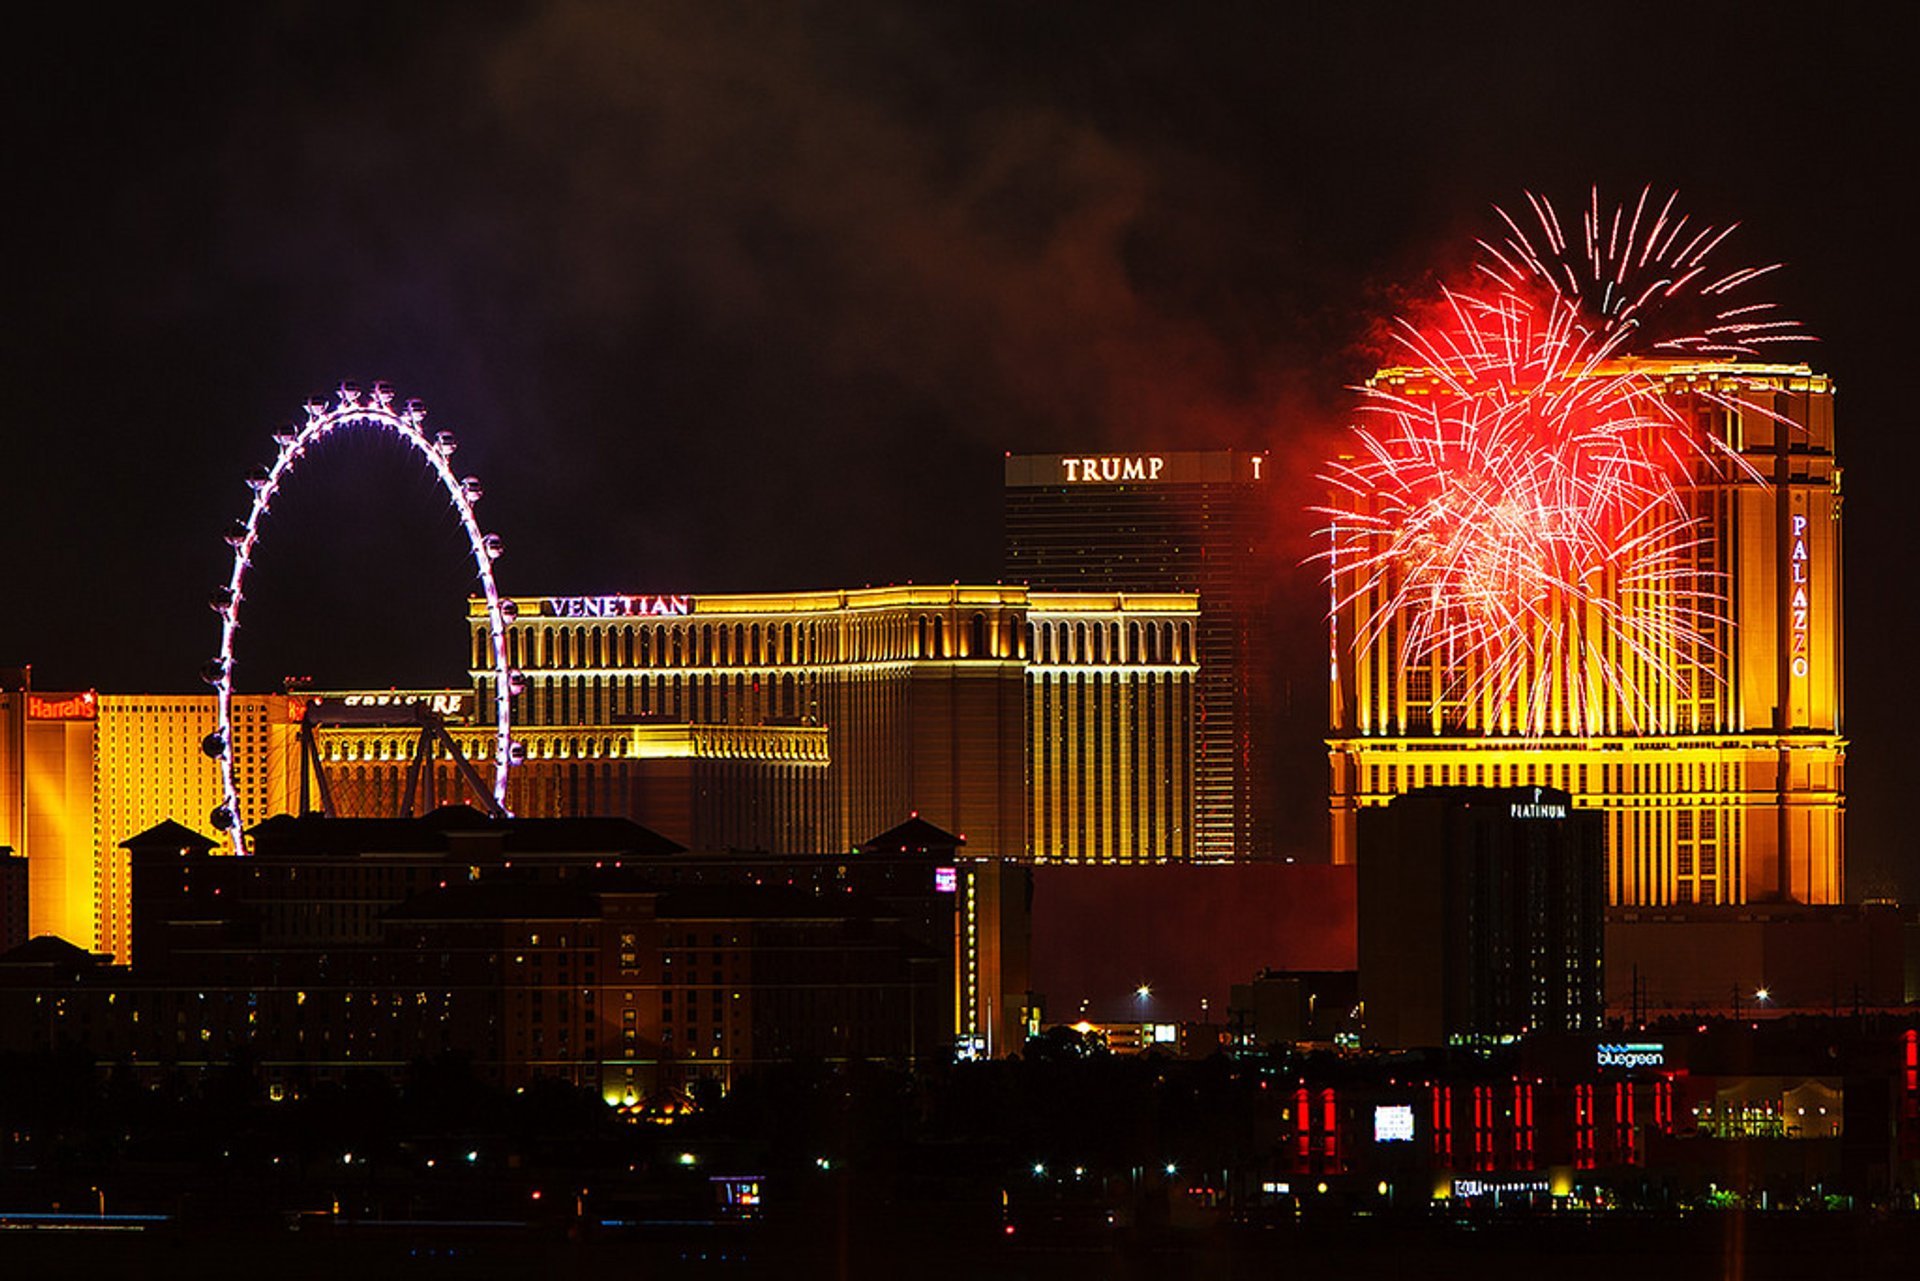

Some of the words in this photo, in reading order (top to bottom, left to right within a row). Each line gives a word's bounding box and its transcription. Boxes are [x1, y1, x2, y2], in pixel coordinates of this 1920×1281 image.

[1062, 457, 1164, 481] TRUMP
[1251, 456, 1262, 480] T
[549, 594, 690, 618] VENETIAN
[1792, 515, 1808, 678] PALAZZO
[1511, 803, 1567, 819] PLATINUM
[1597, 1051, 1664, 1069] bluegreen
